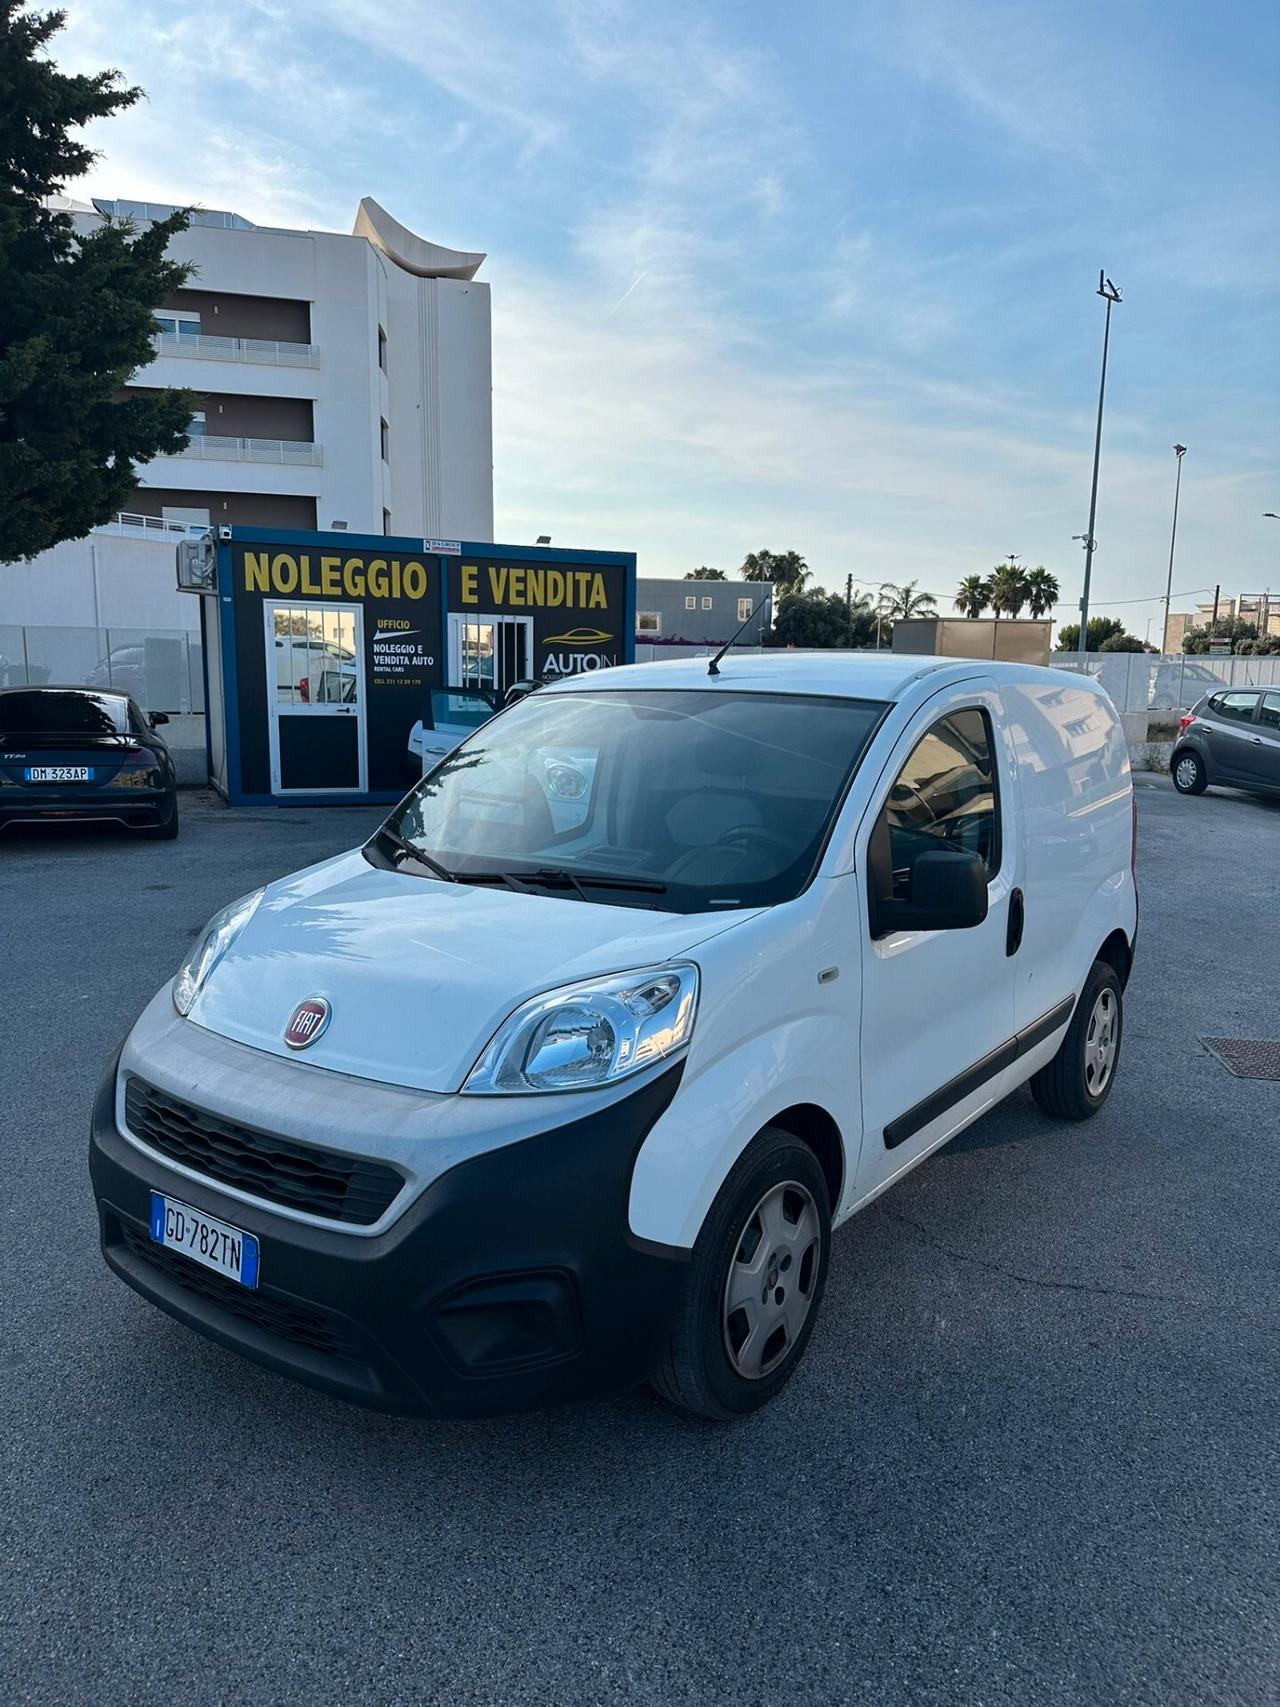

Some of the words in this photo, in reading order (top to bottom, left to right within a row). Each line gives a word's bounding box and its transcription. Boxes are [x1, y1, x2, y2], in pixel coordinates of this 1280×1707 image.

[244, 552, 427, 600] NOLEGGIO
[461, 565, 479, 604] E
[488, 567, 608, 609] VENDITA
[377, 619, 410, 629] UFFICIO
[373, 643, 415, 654] NOLEGGIO
[417, 645, 423, 654] E
[373, 655, 410, 665] VENDITA
[411, 656, 434, 666] AUTO
[32, 768, 47, 780] DM
[51, 768, 87, 780] 323AP
[291, 1009, 322, 1036] FIAT
[189, 1217, 241, 1272] 782TN
